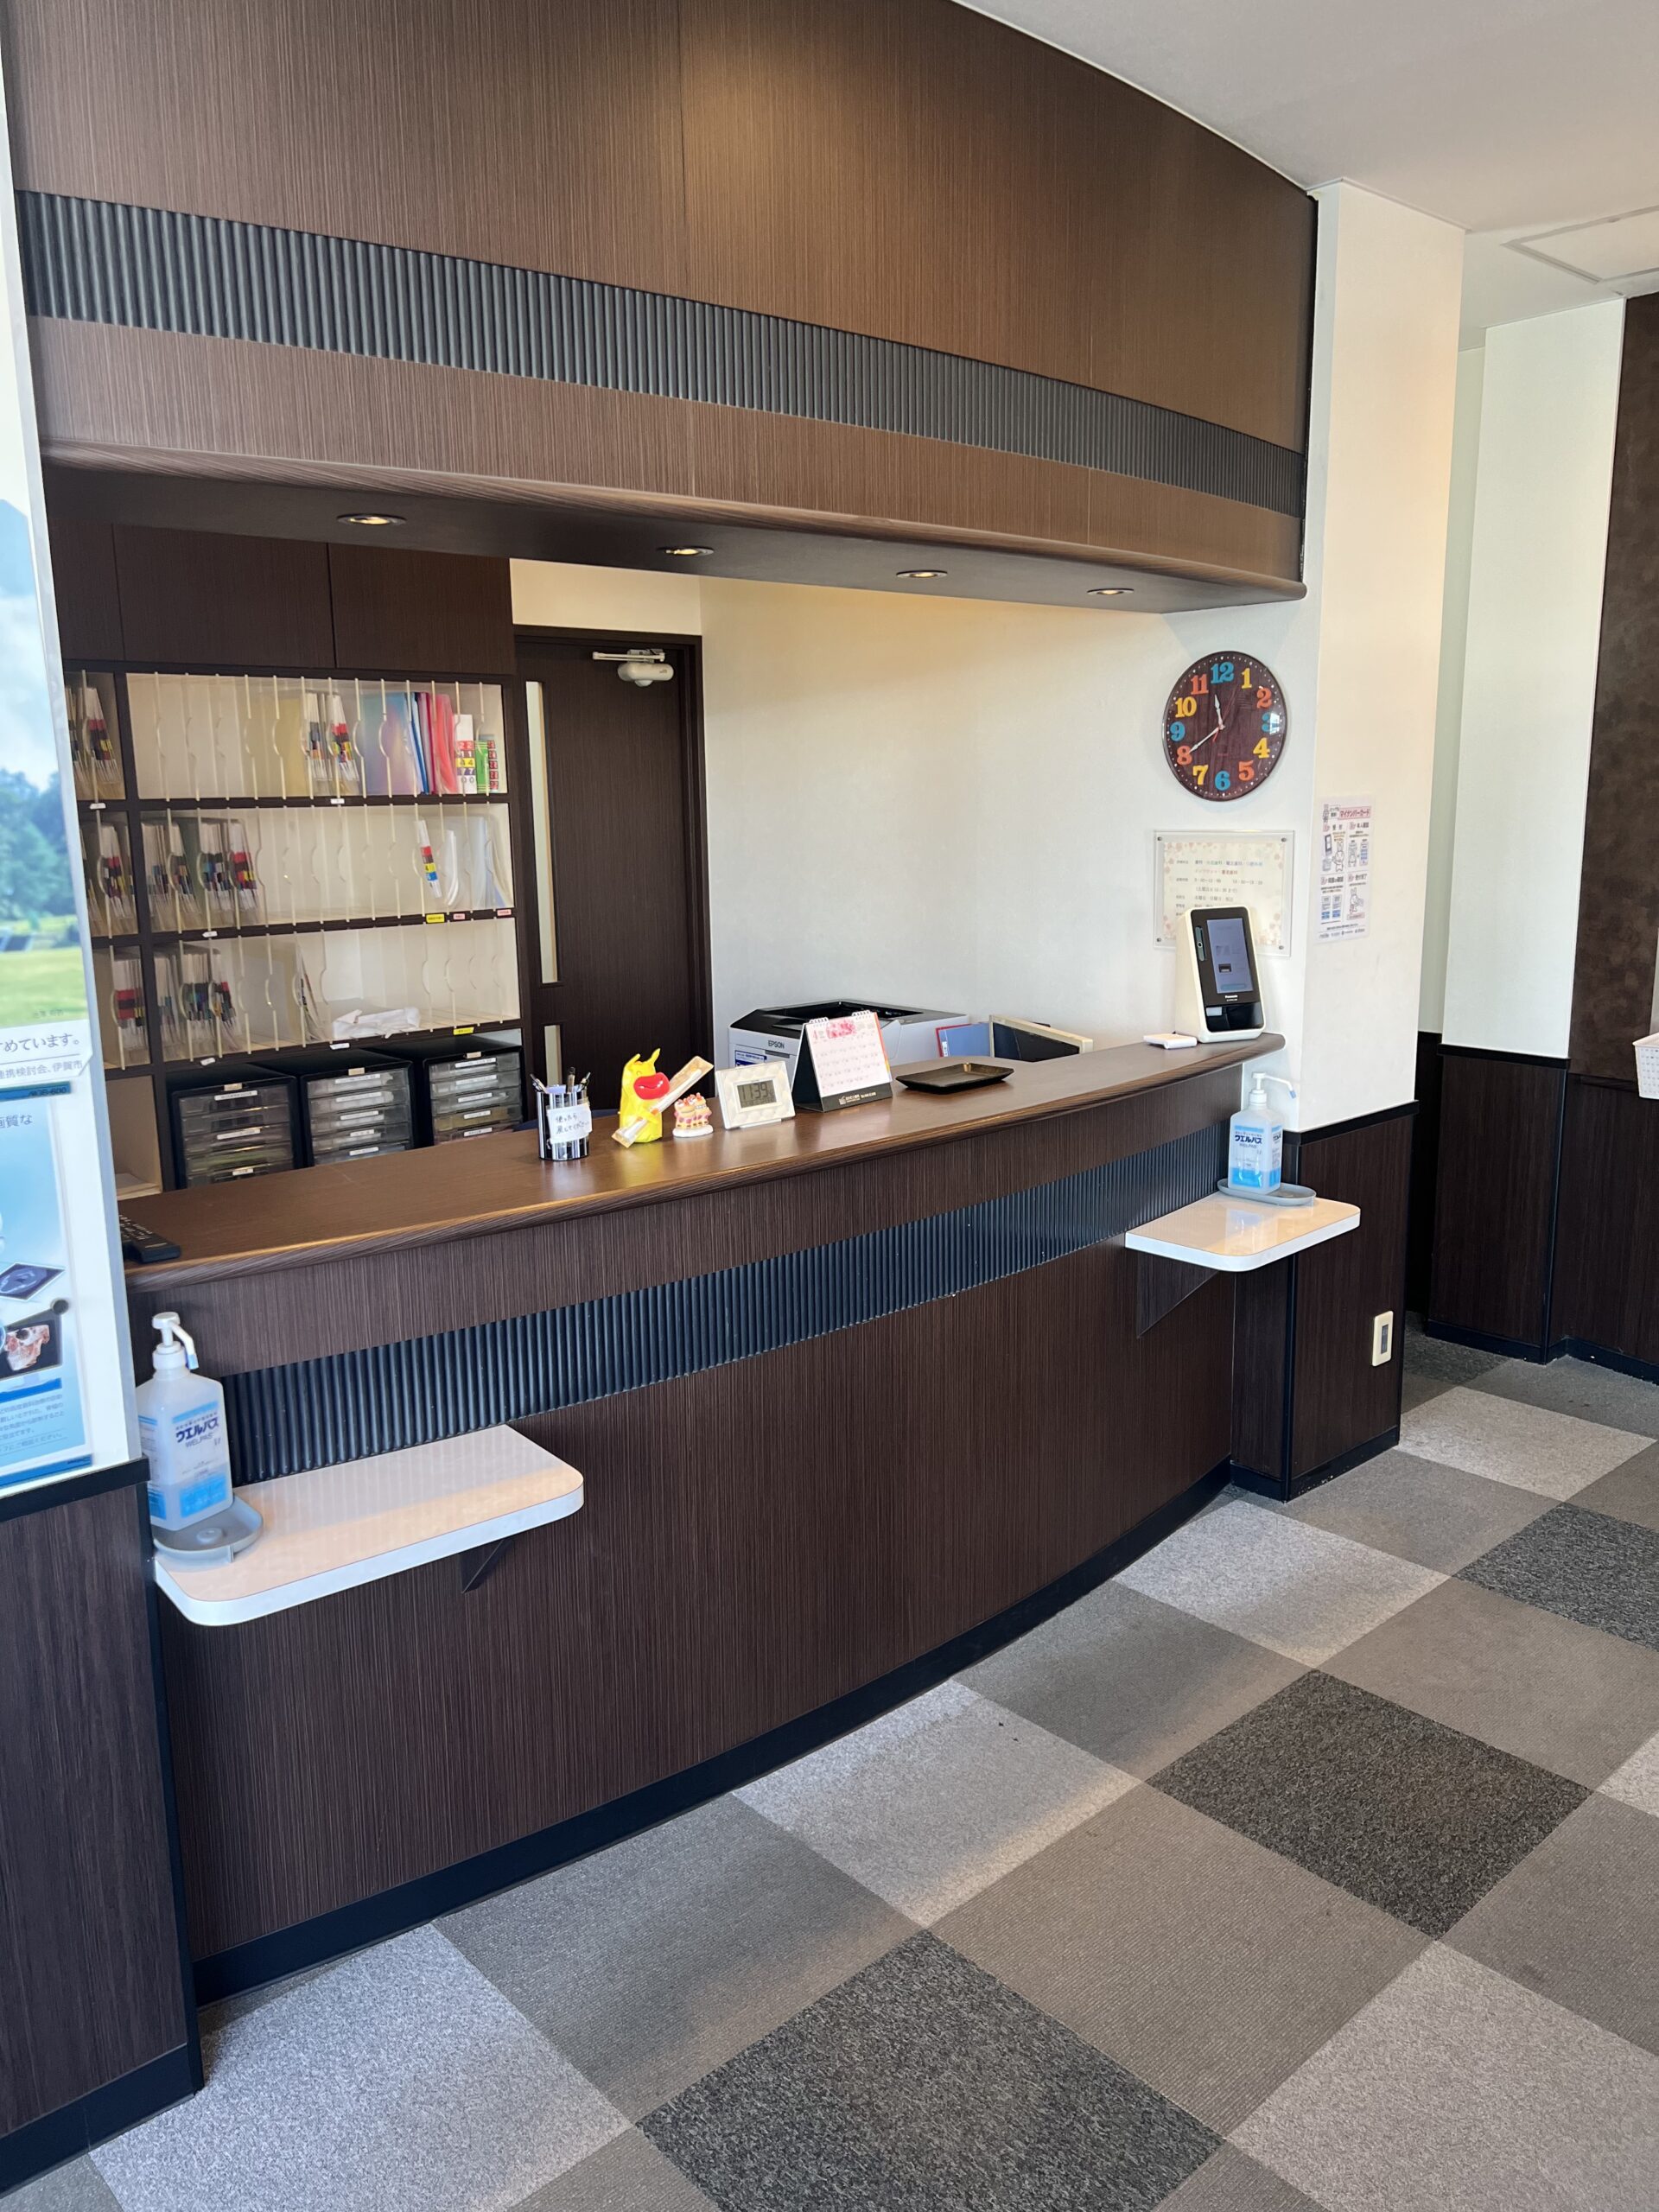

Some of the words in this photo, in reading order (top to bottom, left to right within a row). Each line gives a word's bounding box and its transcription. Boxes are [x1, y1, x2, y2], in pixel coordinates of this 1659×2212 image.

[1211, 662, 1235, 684] 12
[1242, 668, 1253, 690] 1
[1191, 674, 1209, 696] 11
[1175, 696, 1197, 718] 10
[1257, 688, 1272, 709] 2
[1170, 721, 1185, 742] 9
[1177, 746, 1192, 766] 8
[1253, 737, 1270, 759] 4
[1192, 765, 1208, 785] 7
[1215, 771, 1230, 791] 6
[1238, 760, 1255, 781] 5
[0, 1033, 79, 1052] めています。
[767, 1039, 785, 1050] EPSON
